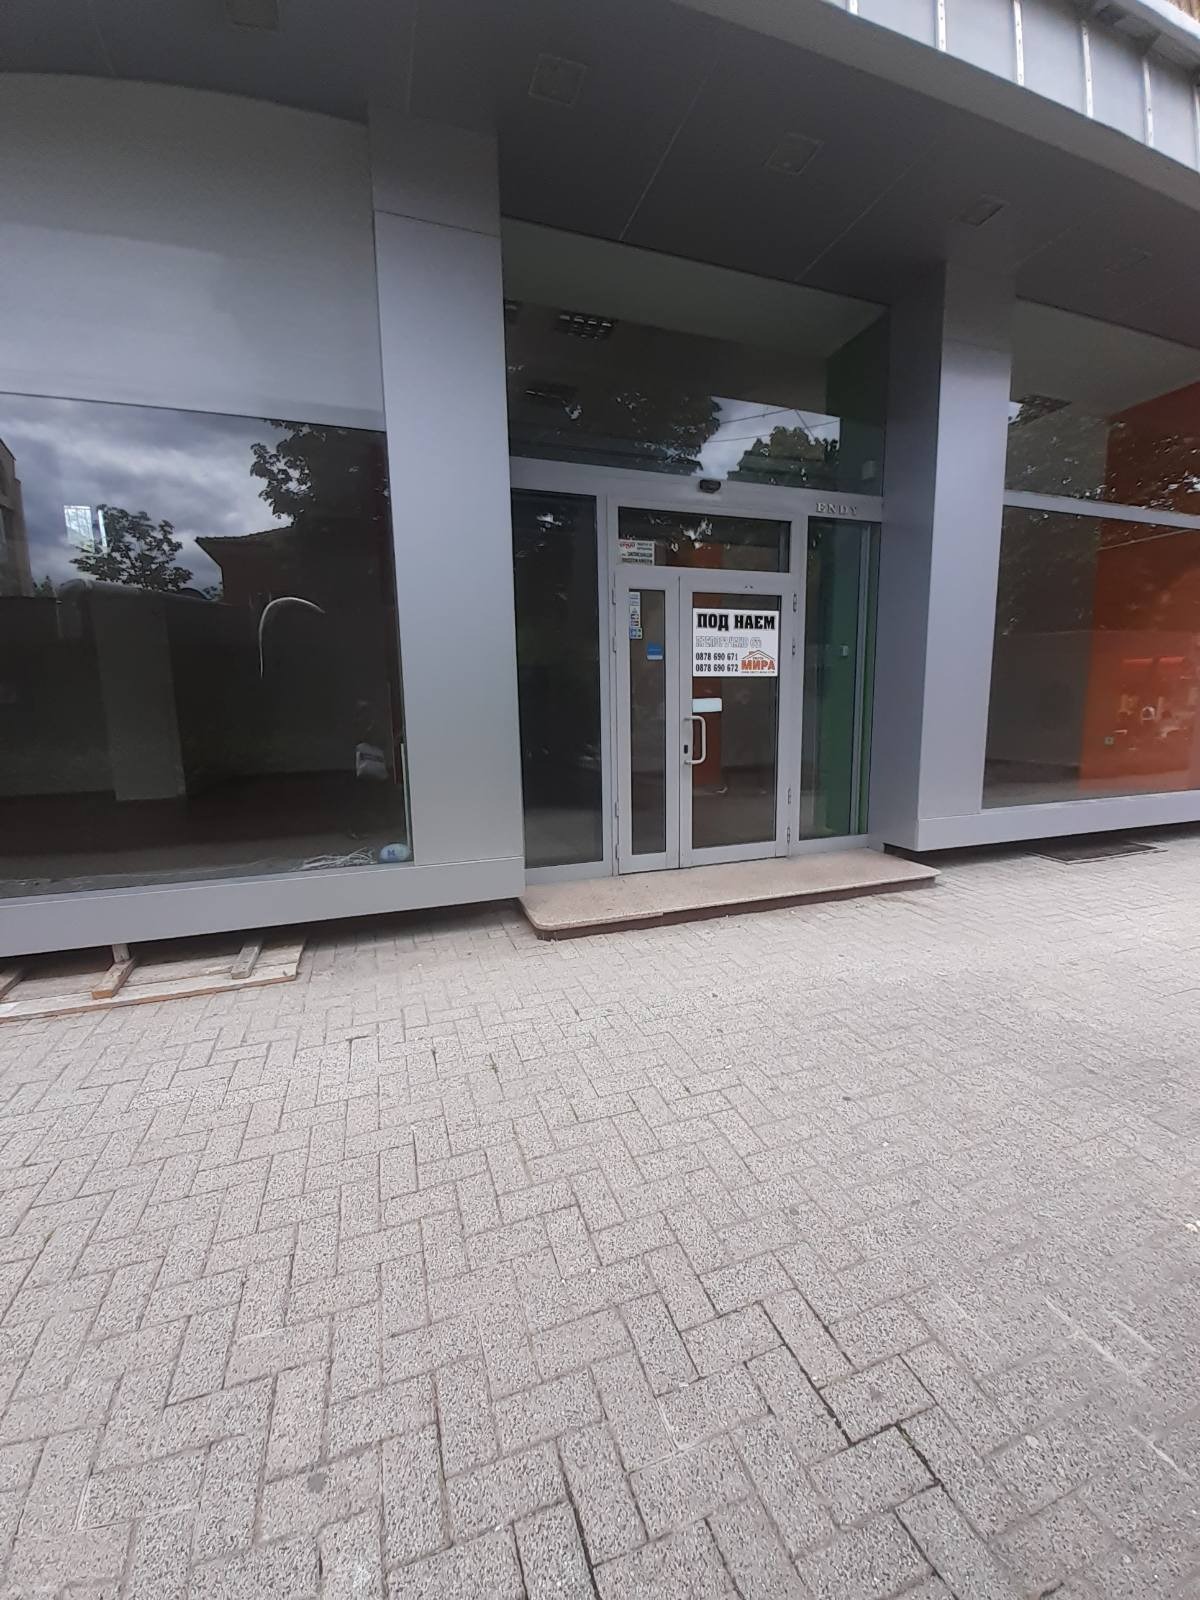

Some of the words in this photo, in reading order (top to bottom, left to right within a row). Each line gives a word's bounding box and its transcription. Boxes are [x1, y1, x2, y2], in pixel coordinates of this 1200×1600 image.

[697, 613, 729, 632] ПОД
[734, 614, 776, 630] НАЕМ
[695, 652, 712, 661] 0878
[713, 652, 726, 661] 690
[726, 652, 738, 661] 671
[695, 663, 712, 672] 0878
[713, 663, 726, 672] 690
[726, 663, 739, 672] 672
[741, 659, 776, 671] МИРА
